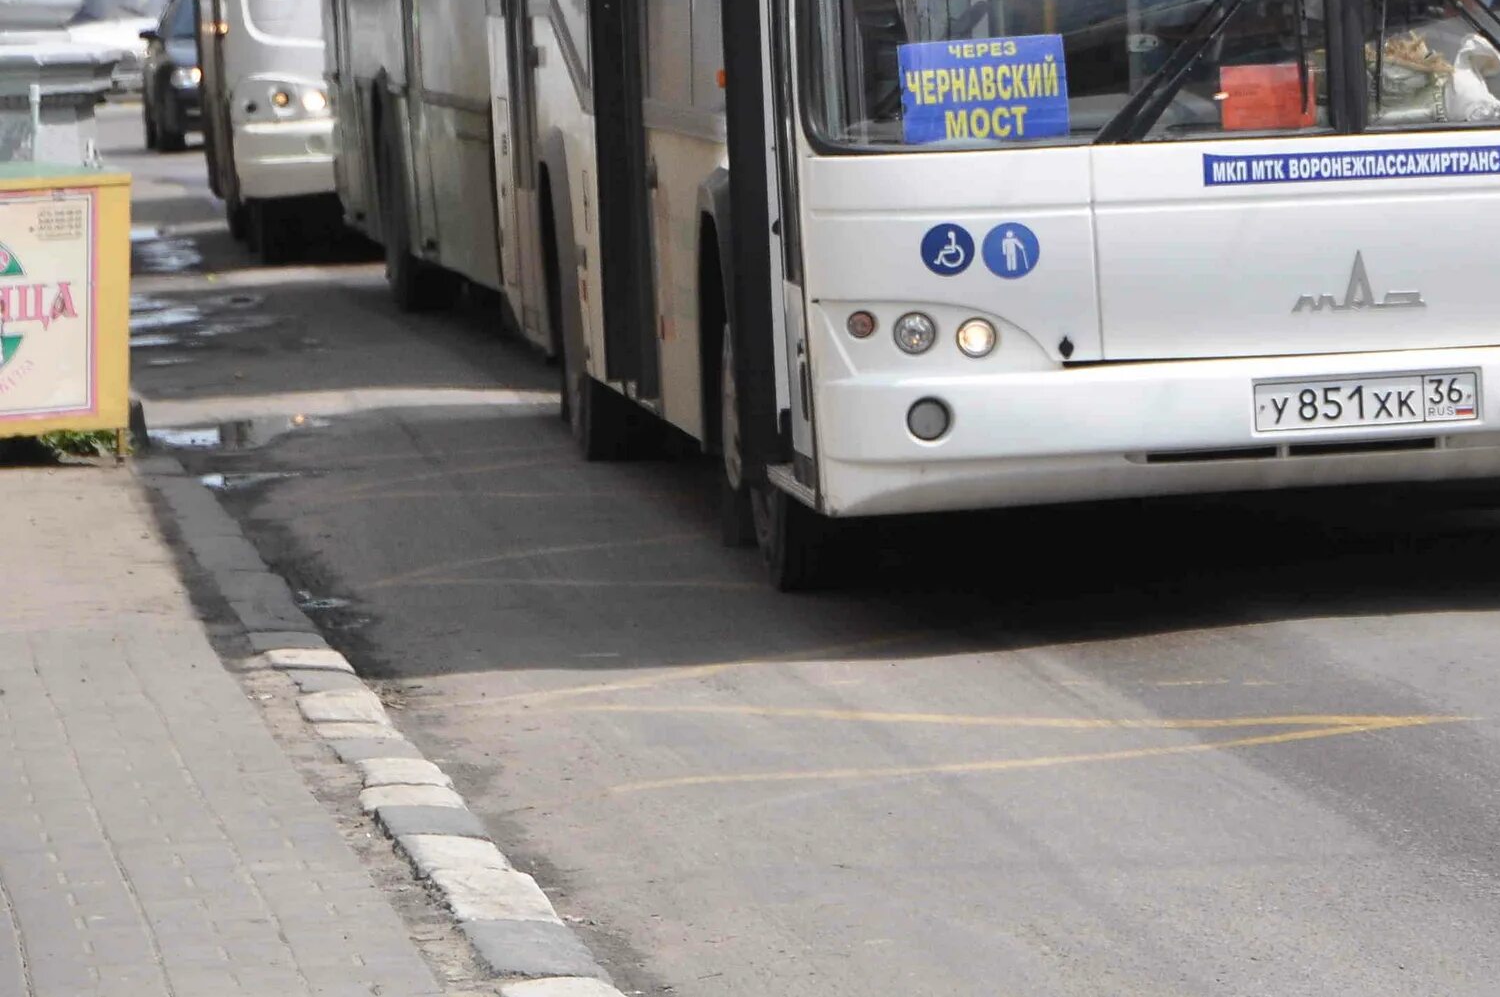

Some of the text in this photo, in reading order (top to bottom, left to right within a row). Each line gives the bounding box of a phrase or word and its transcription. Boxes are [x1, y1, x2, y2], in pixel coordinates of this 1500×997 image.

[948, 40, 1018, 58] ЧЕРЕЗ
[906, 54, 1059, 105] ЧЕРНАВСКИЙ
[944, 106, 1028, 141] МОСТ
[1212, 150, 1500, 182] МКП МТК ВОРОНЕЖПАССАЖИРТРАНС
[1428, 377, 1464, 405] 36
[1428, 406, 1454, 417] RUS
